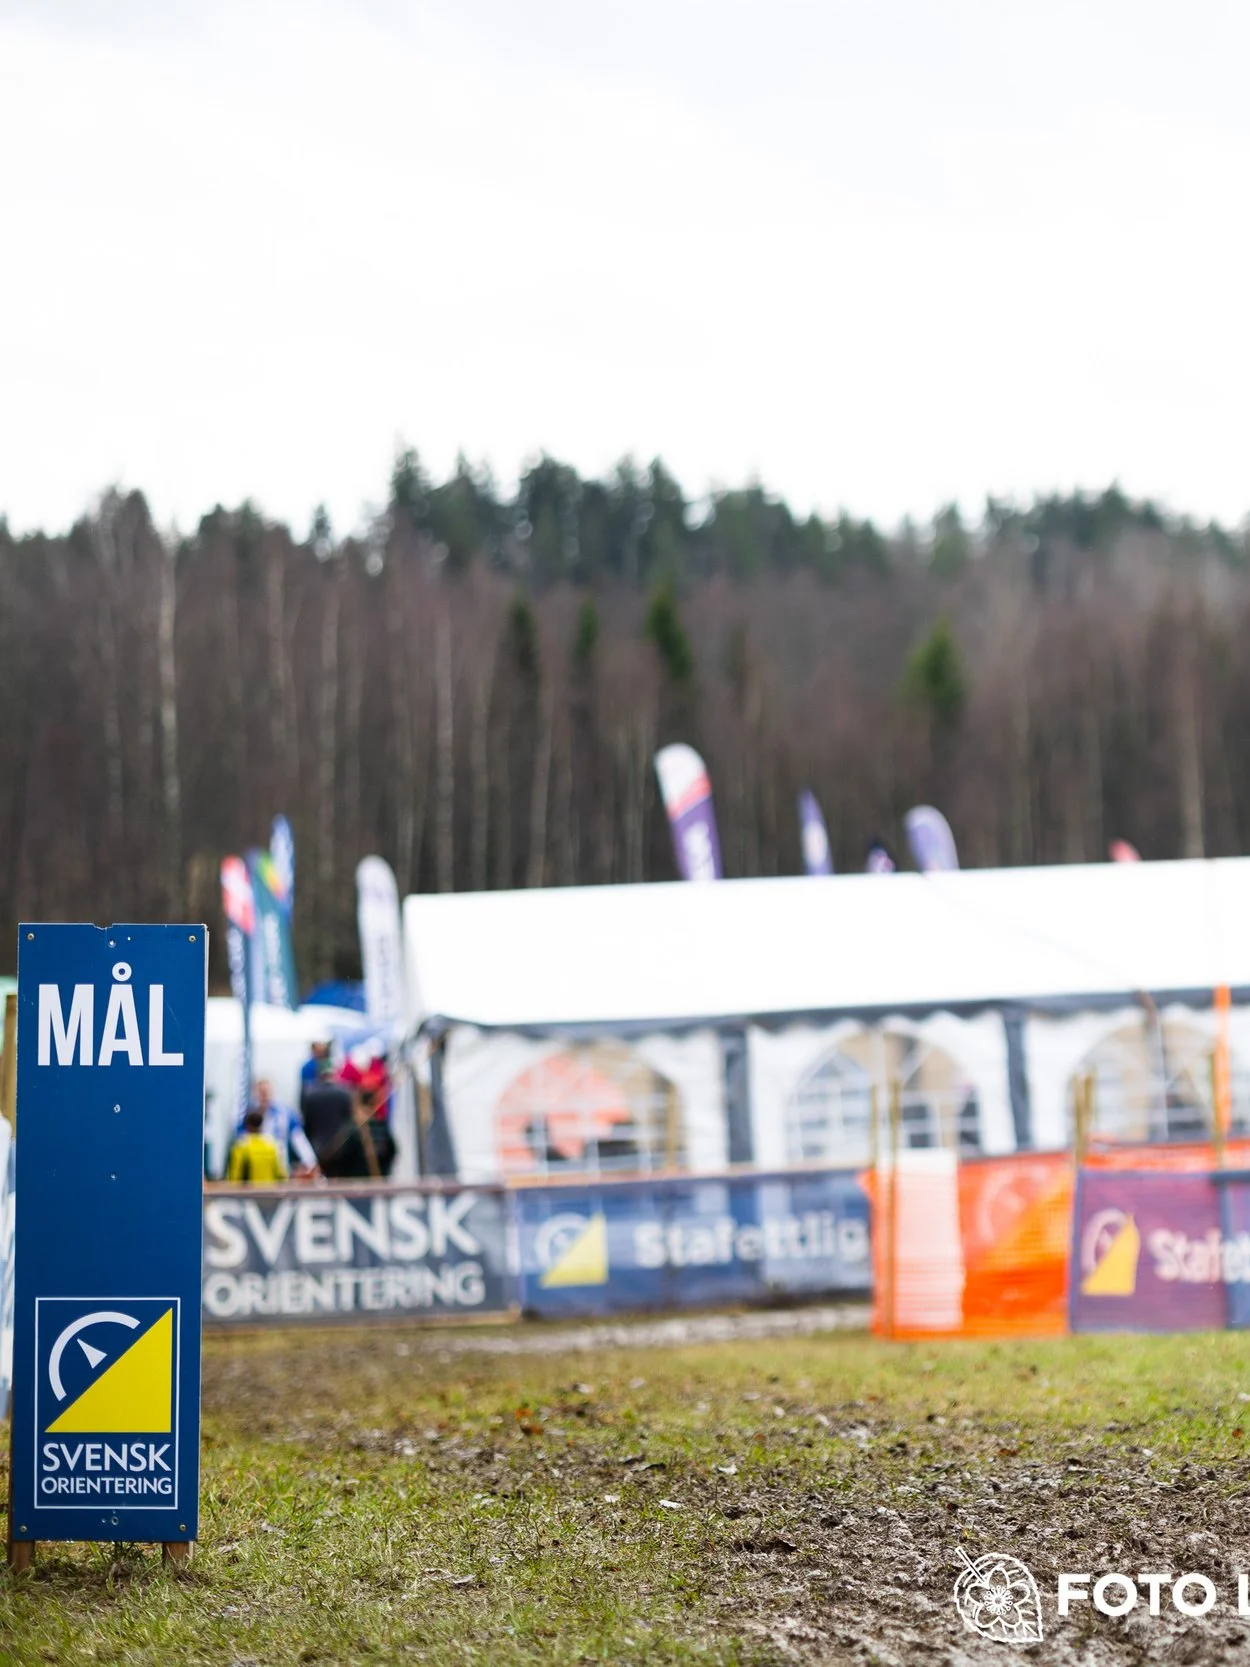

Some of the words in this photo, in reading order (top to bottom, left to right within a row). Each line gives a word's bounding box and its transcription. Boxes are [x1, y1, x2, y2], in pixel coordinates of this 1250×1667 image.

[38, 962, 184, 1066] MÅL
[204, 1190, 482, 1269] SVENSK
[204, 1261, 486, 1318] ORIENTERING
[41, 1476, 173, 1495] ORIENTERING
[42, 1442, 172, 1472] SVENSK
